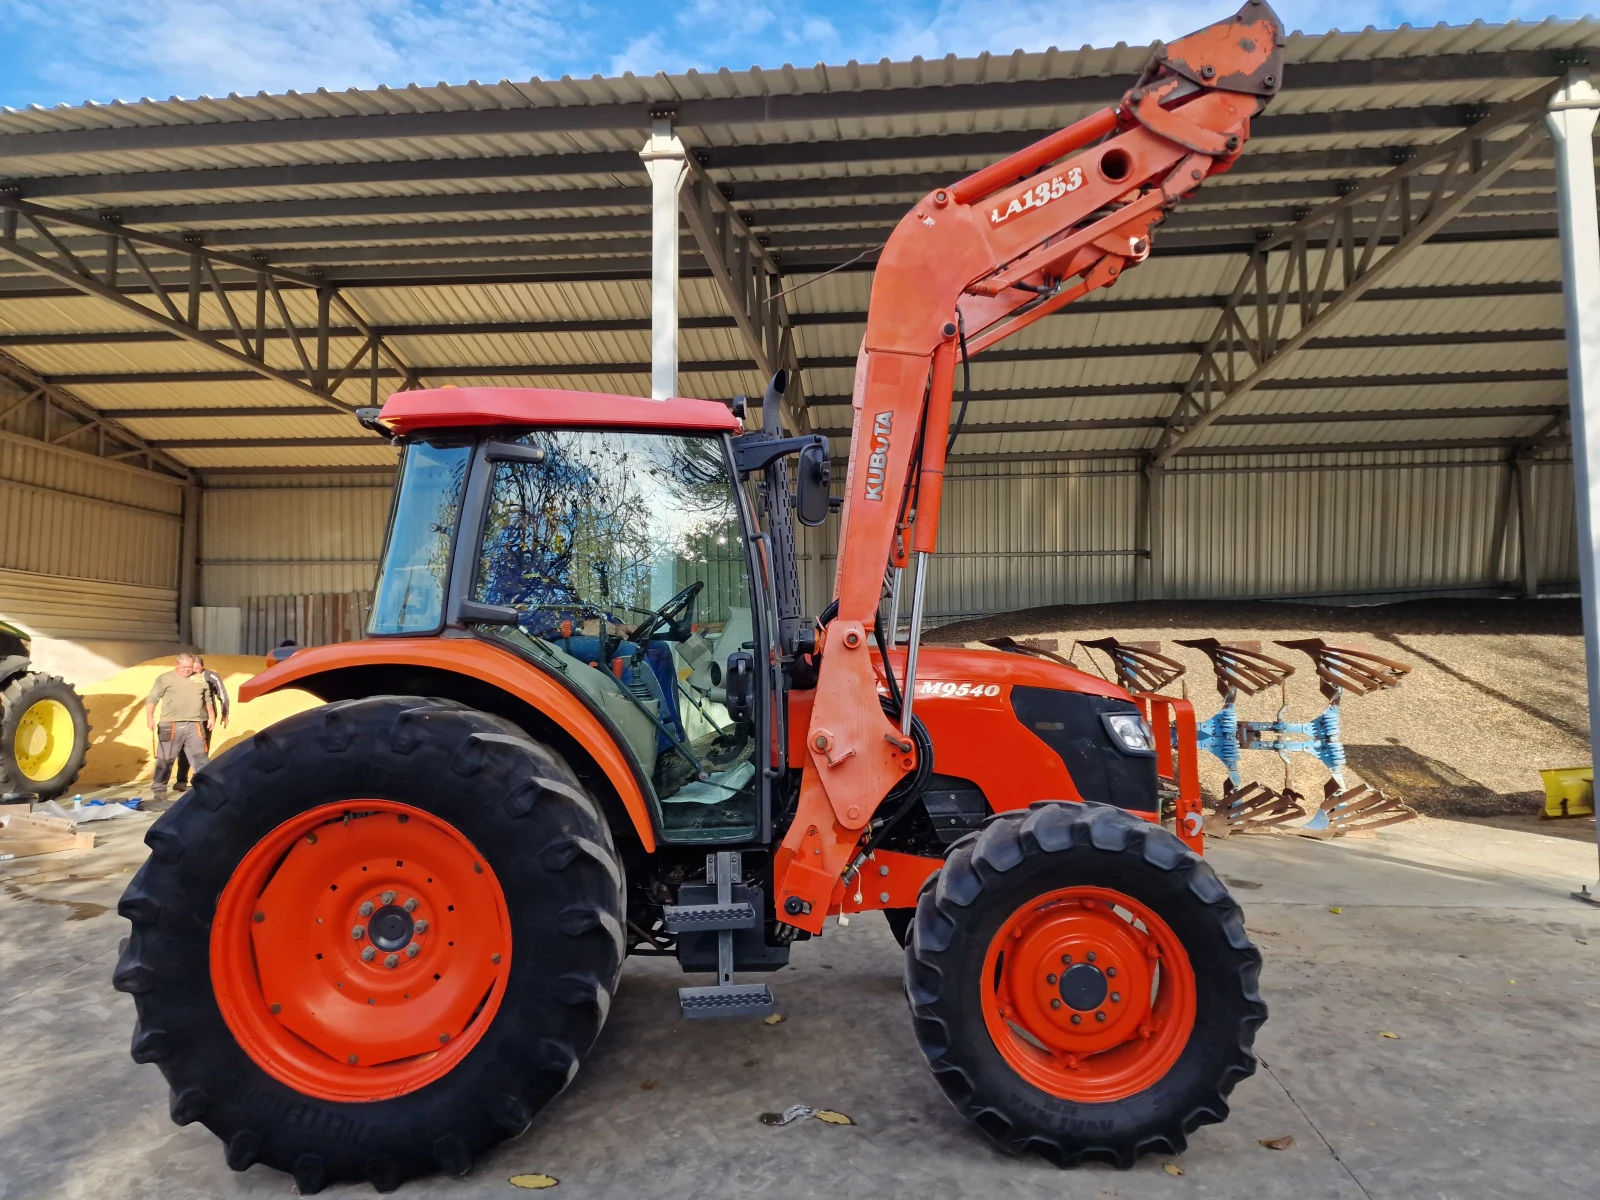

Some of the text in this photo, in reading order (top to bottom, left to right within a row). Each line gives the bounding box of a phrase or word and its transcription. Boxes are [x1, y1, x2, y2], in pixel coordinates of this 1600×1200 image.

[991, 167, 1083, 224] LA1353
[864, 411, 893, 501] KUBOTA
[918, 681, 1000, 697] M9540
